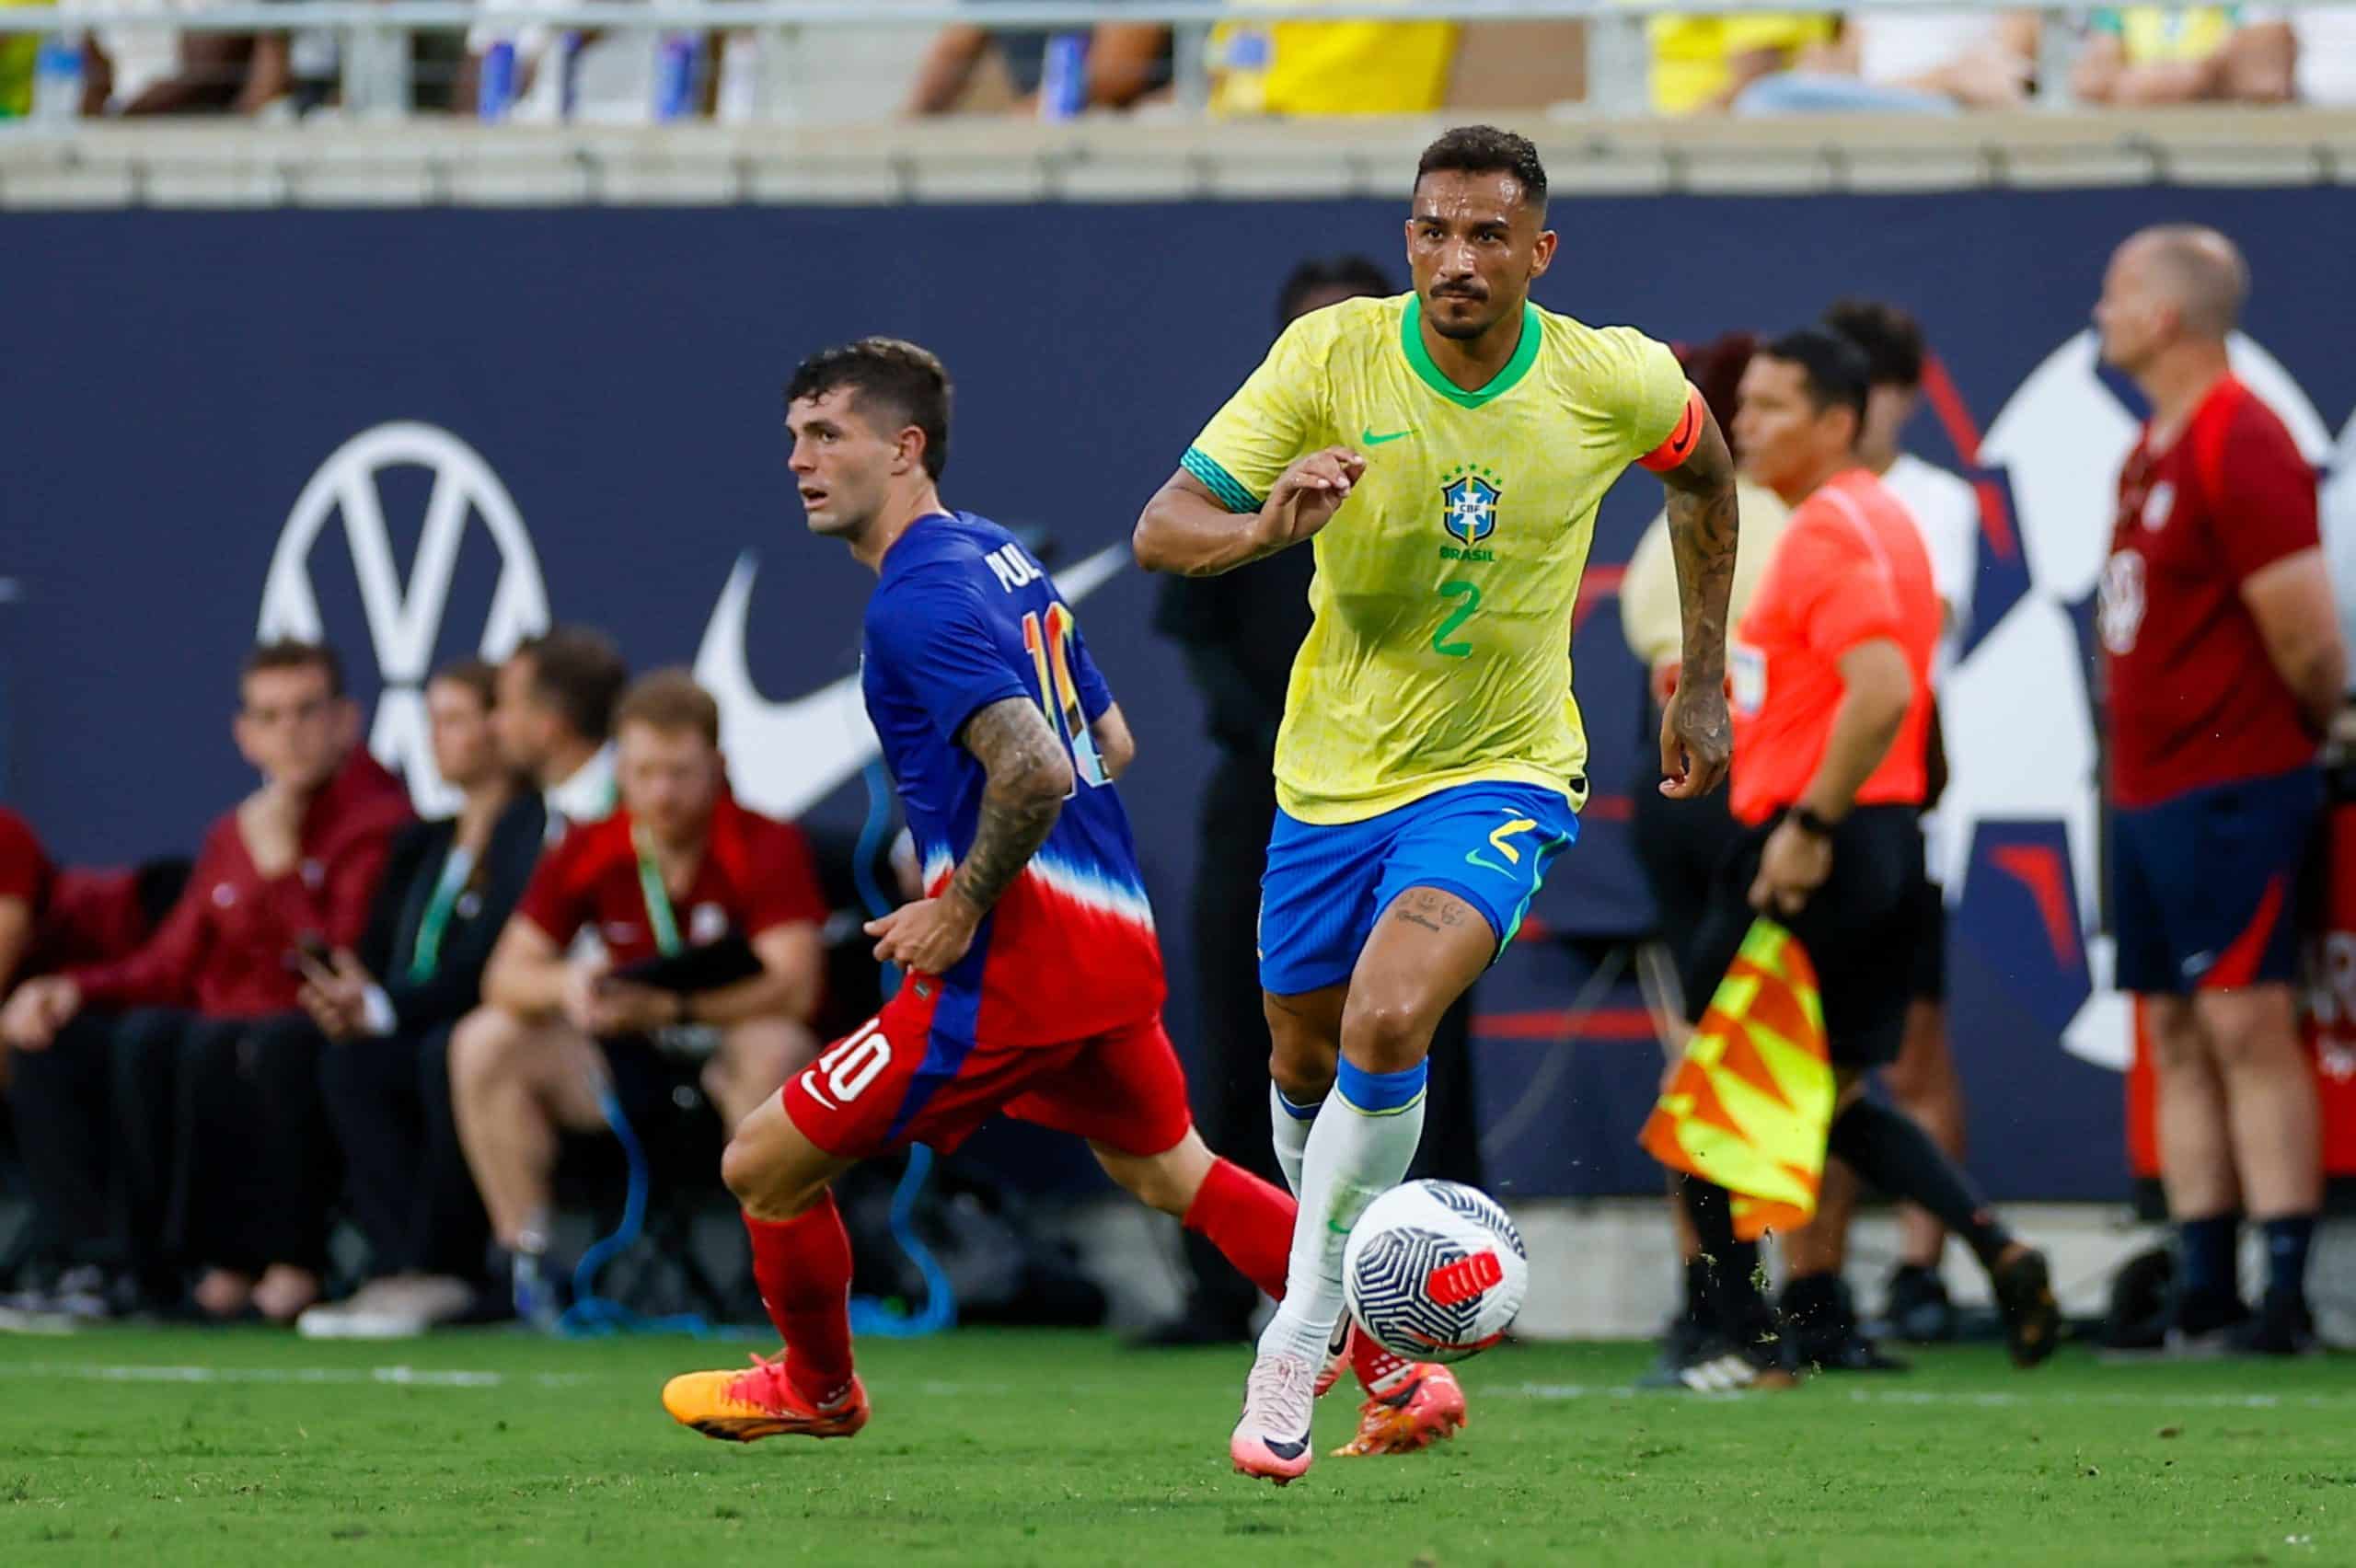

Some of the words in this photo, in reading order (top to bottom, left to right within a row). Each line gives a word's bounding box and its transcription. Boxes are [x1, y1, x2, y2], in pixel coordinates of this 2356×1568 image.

[1459, 503, 1482, 514] CBF
[1438, 546, 1496, 562] BRASIL
[1432, 580, 1482, 658] 2
[1022, 600, 1114, 801] 10
[1488, 806, 1539, 866] 2
[817, 1016, 892, 1102] 10
